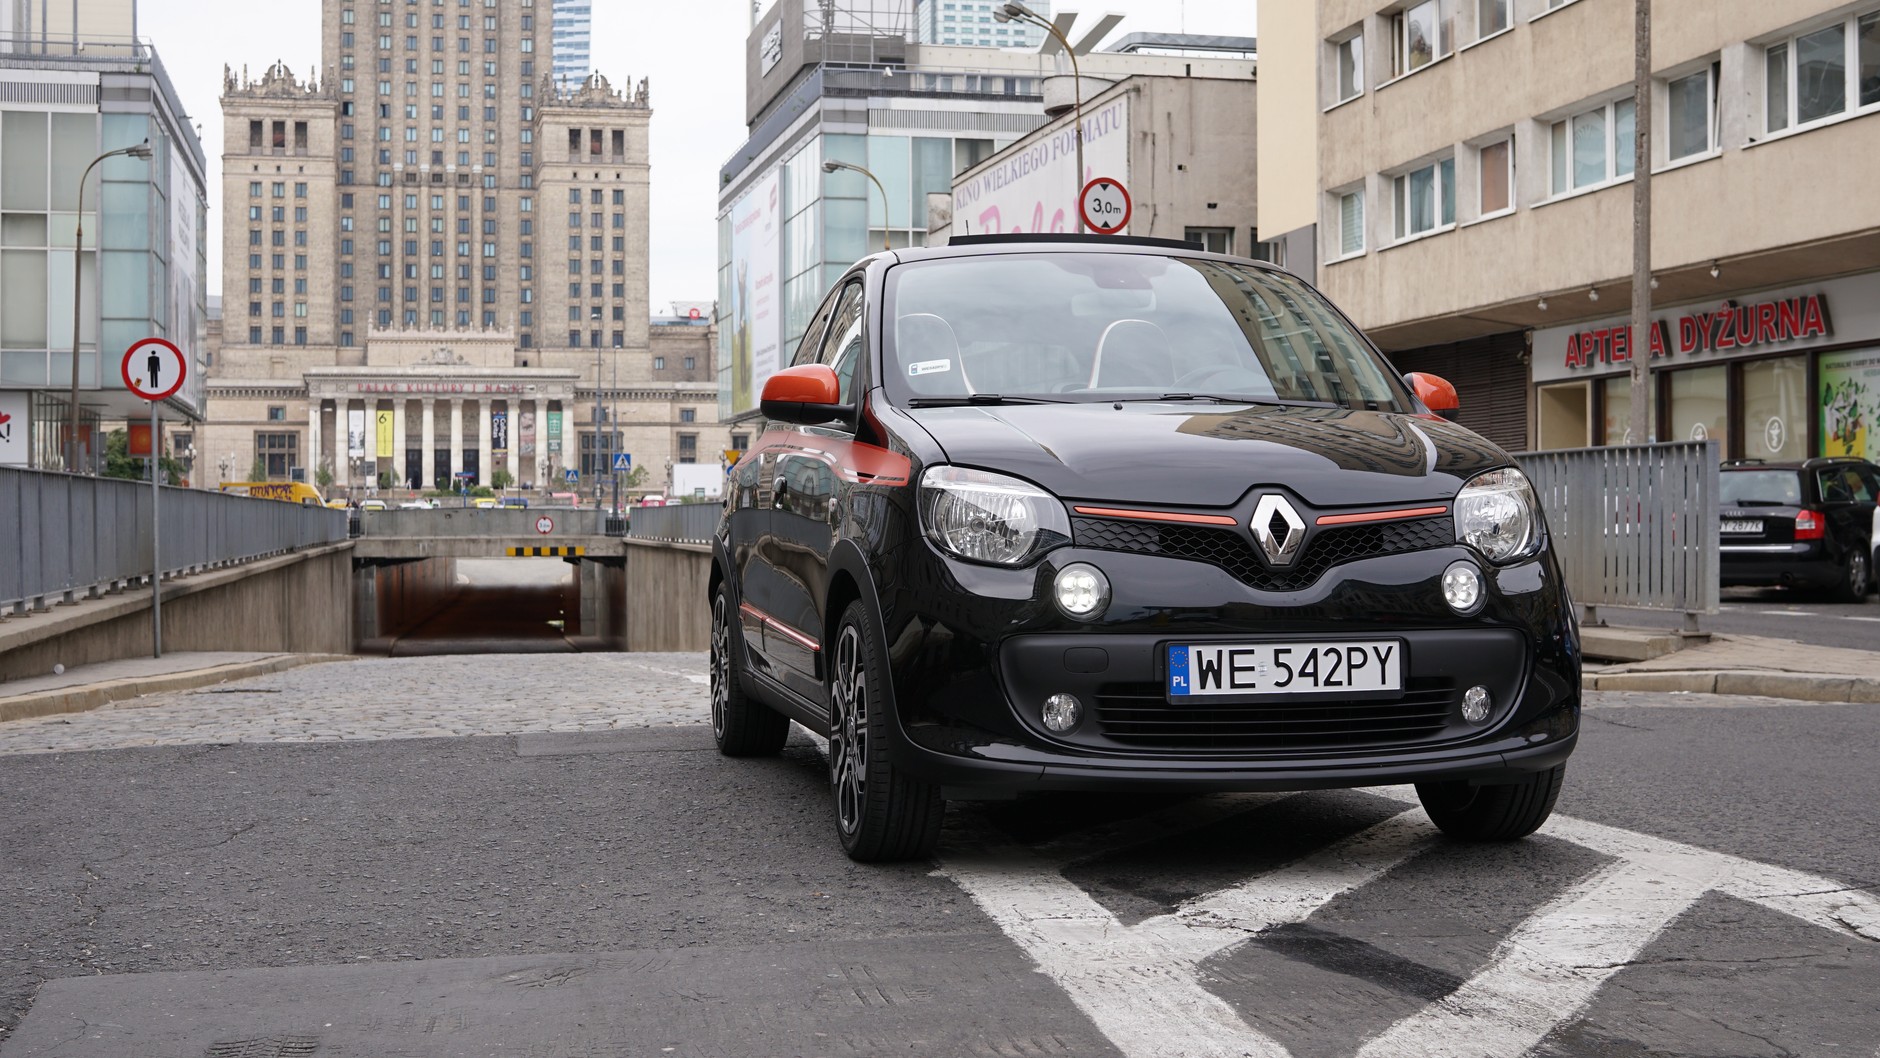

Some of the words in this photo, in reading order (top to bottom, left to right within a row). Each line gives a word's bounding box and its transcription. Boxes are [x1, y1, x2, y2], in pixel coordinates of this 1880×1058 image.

[956, 179, 980, 211] KINO
[983, 143, 1048, 194] WIELKIEGO
[1565, 321, 1666, 368] APTEA
[1679, 295, 1826, 353] DYŻURNA
[407, 383, 465, 393] KULTURY
[472, 383, 477, 393] I
[1172, 676, 1187, 687] PL
[1196, 648, 1256, 690] WE
[1273, 646, 1394, 688] 542PY
